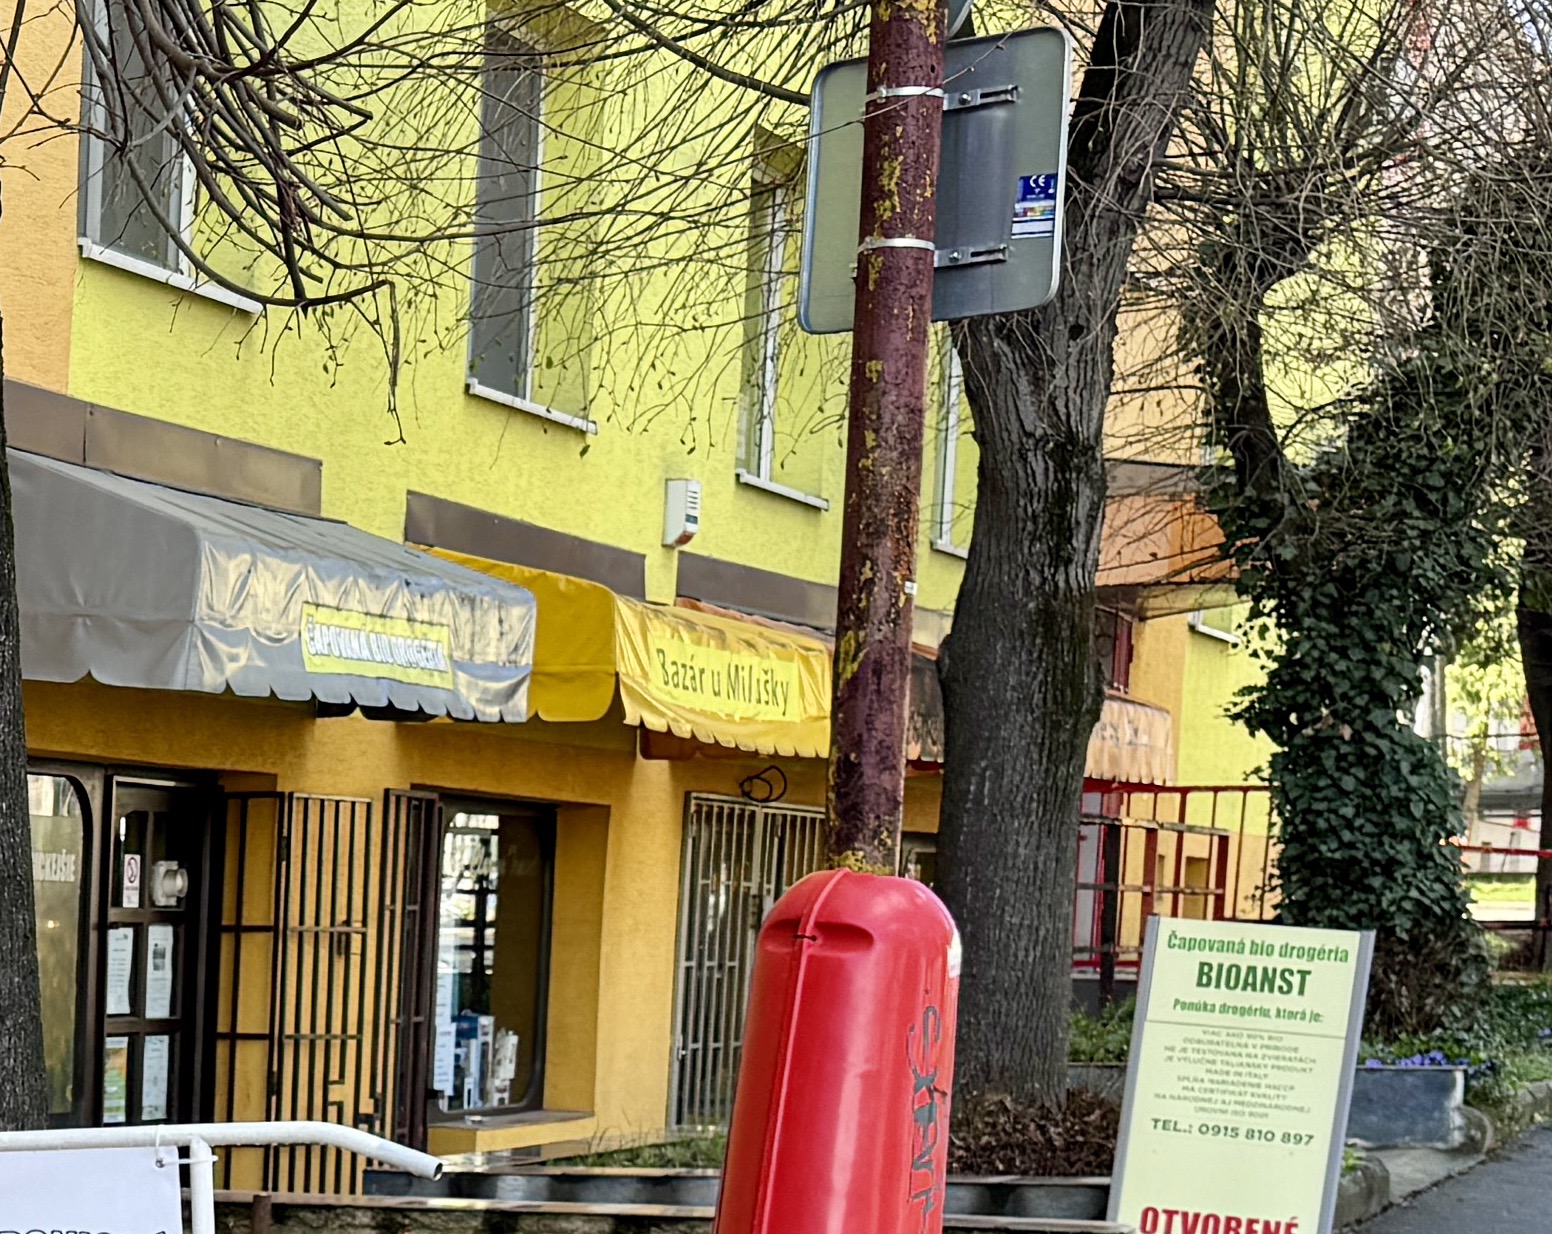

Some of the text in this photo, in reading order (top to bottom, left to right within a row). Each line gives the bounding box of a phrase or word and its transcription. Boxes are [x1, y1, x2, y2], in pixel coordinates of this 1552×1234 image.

[657, 648, 705, 694] Bazár
[712, 670, 721, 697] u
[1167, 930, 1349, 963] Čapovaná bio drogéria
[1196, 961, 1312, 997] BIOANST
[1173, 998, 1216, 1014] Ponúka
[1275, 1007, 1306, 1021] ktorá
[1151, 1118, 1314, 1146] TEL.: 0915 810 897
